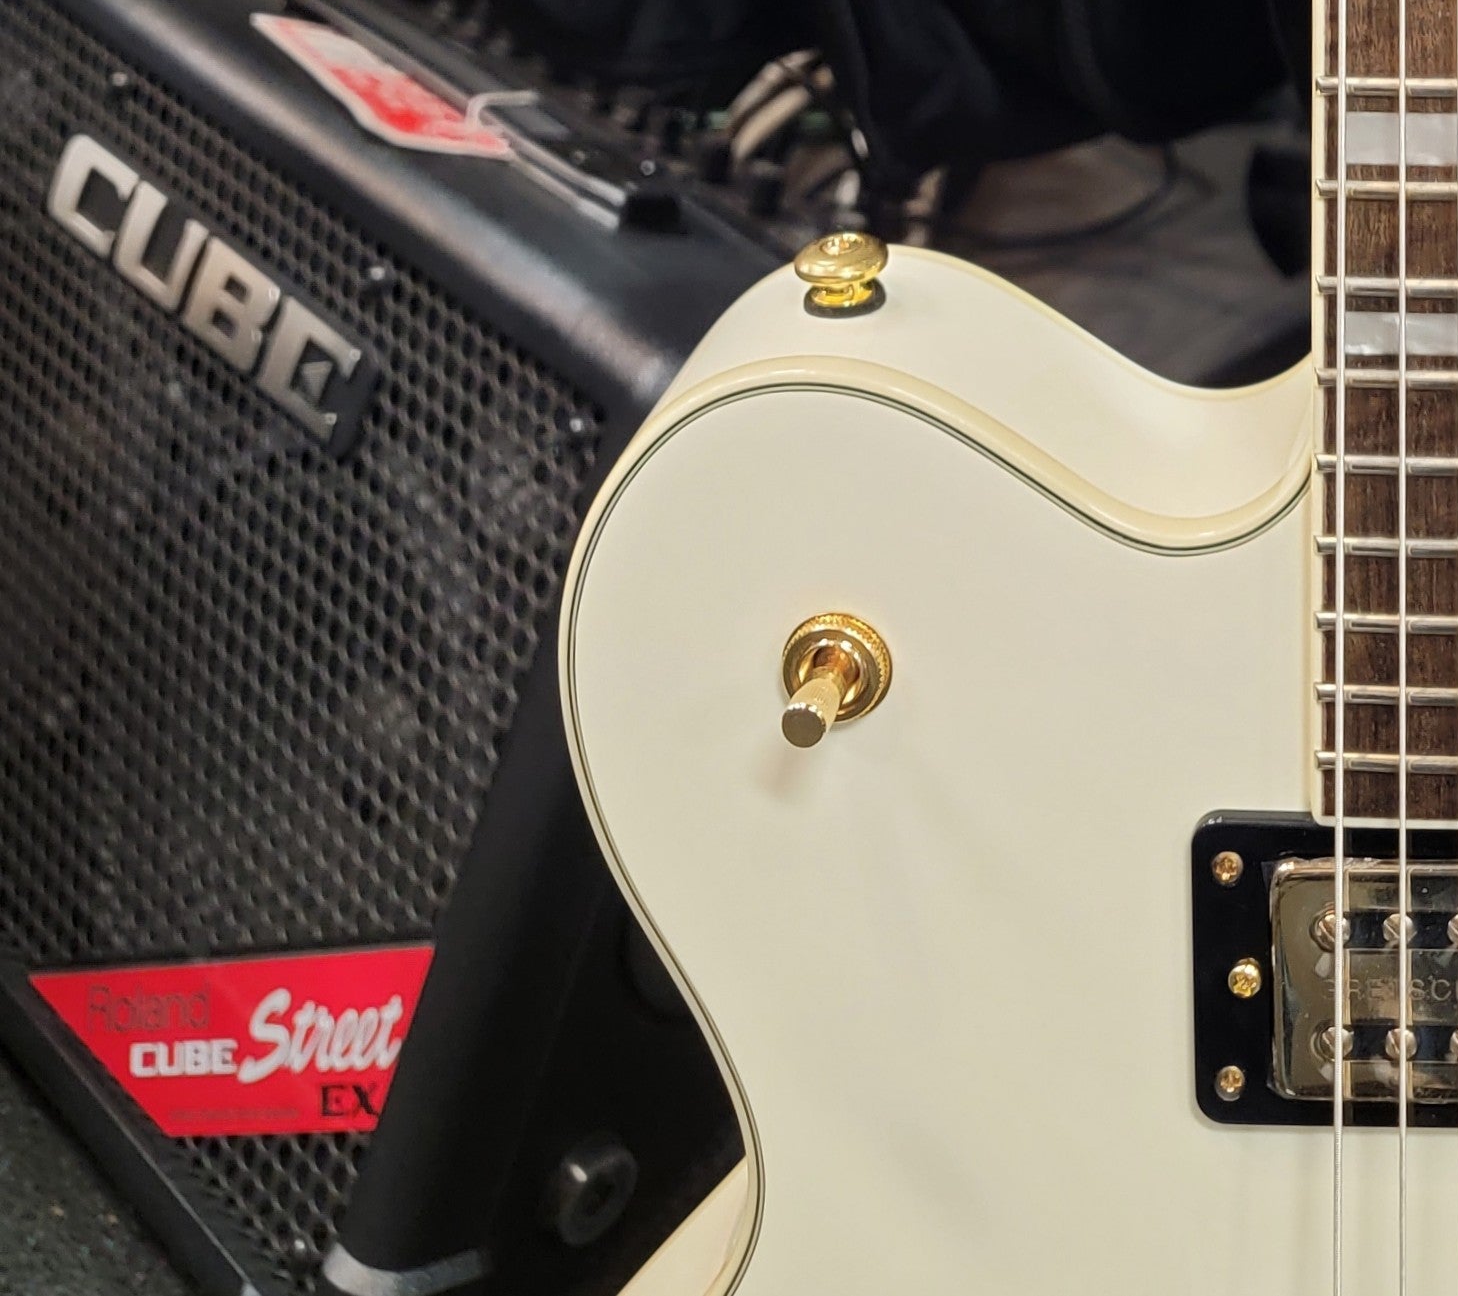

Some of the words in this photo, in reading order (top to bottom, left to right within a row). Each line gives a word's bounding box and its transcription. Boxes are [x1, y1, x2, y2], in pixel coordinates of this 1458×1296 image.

[48, 134, 362, 441] CUBE
[86, 982, 211, 1033] Roland
[129, 1037, 238, 1078] CUBE
[237, 987, 404, 1084] Street
[319, 1081, 380, 1118] EX
